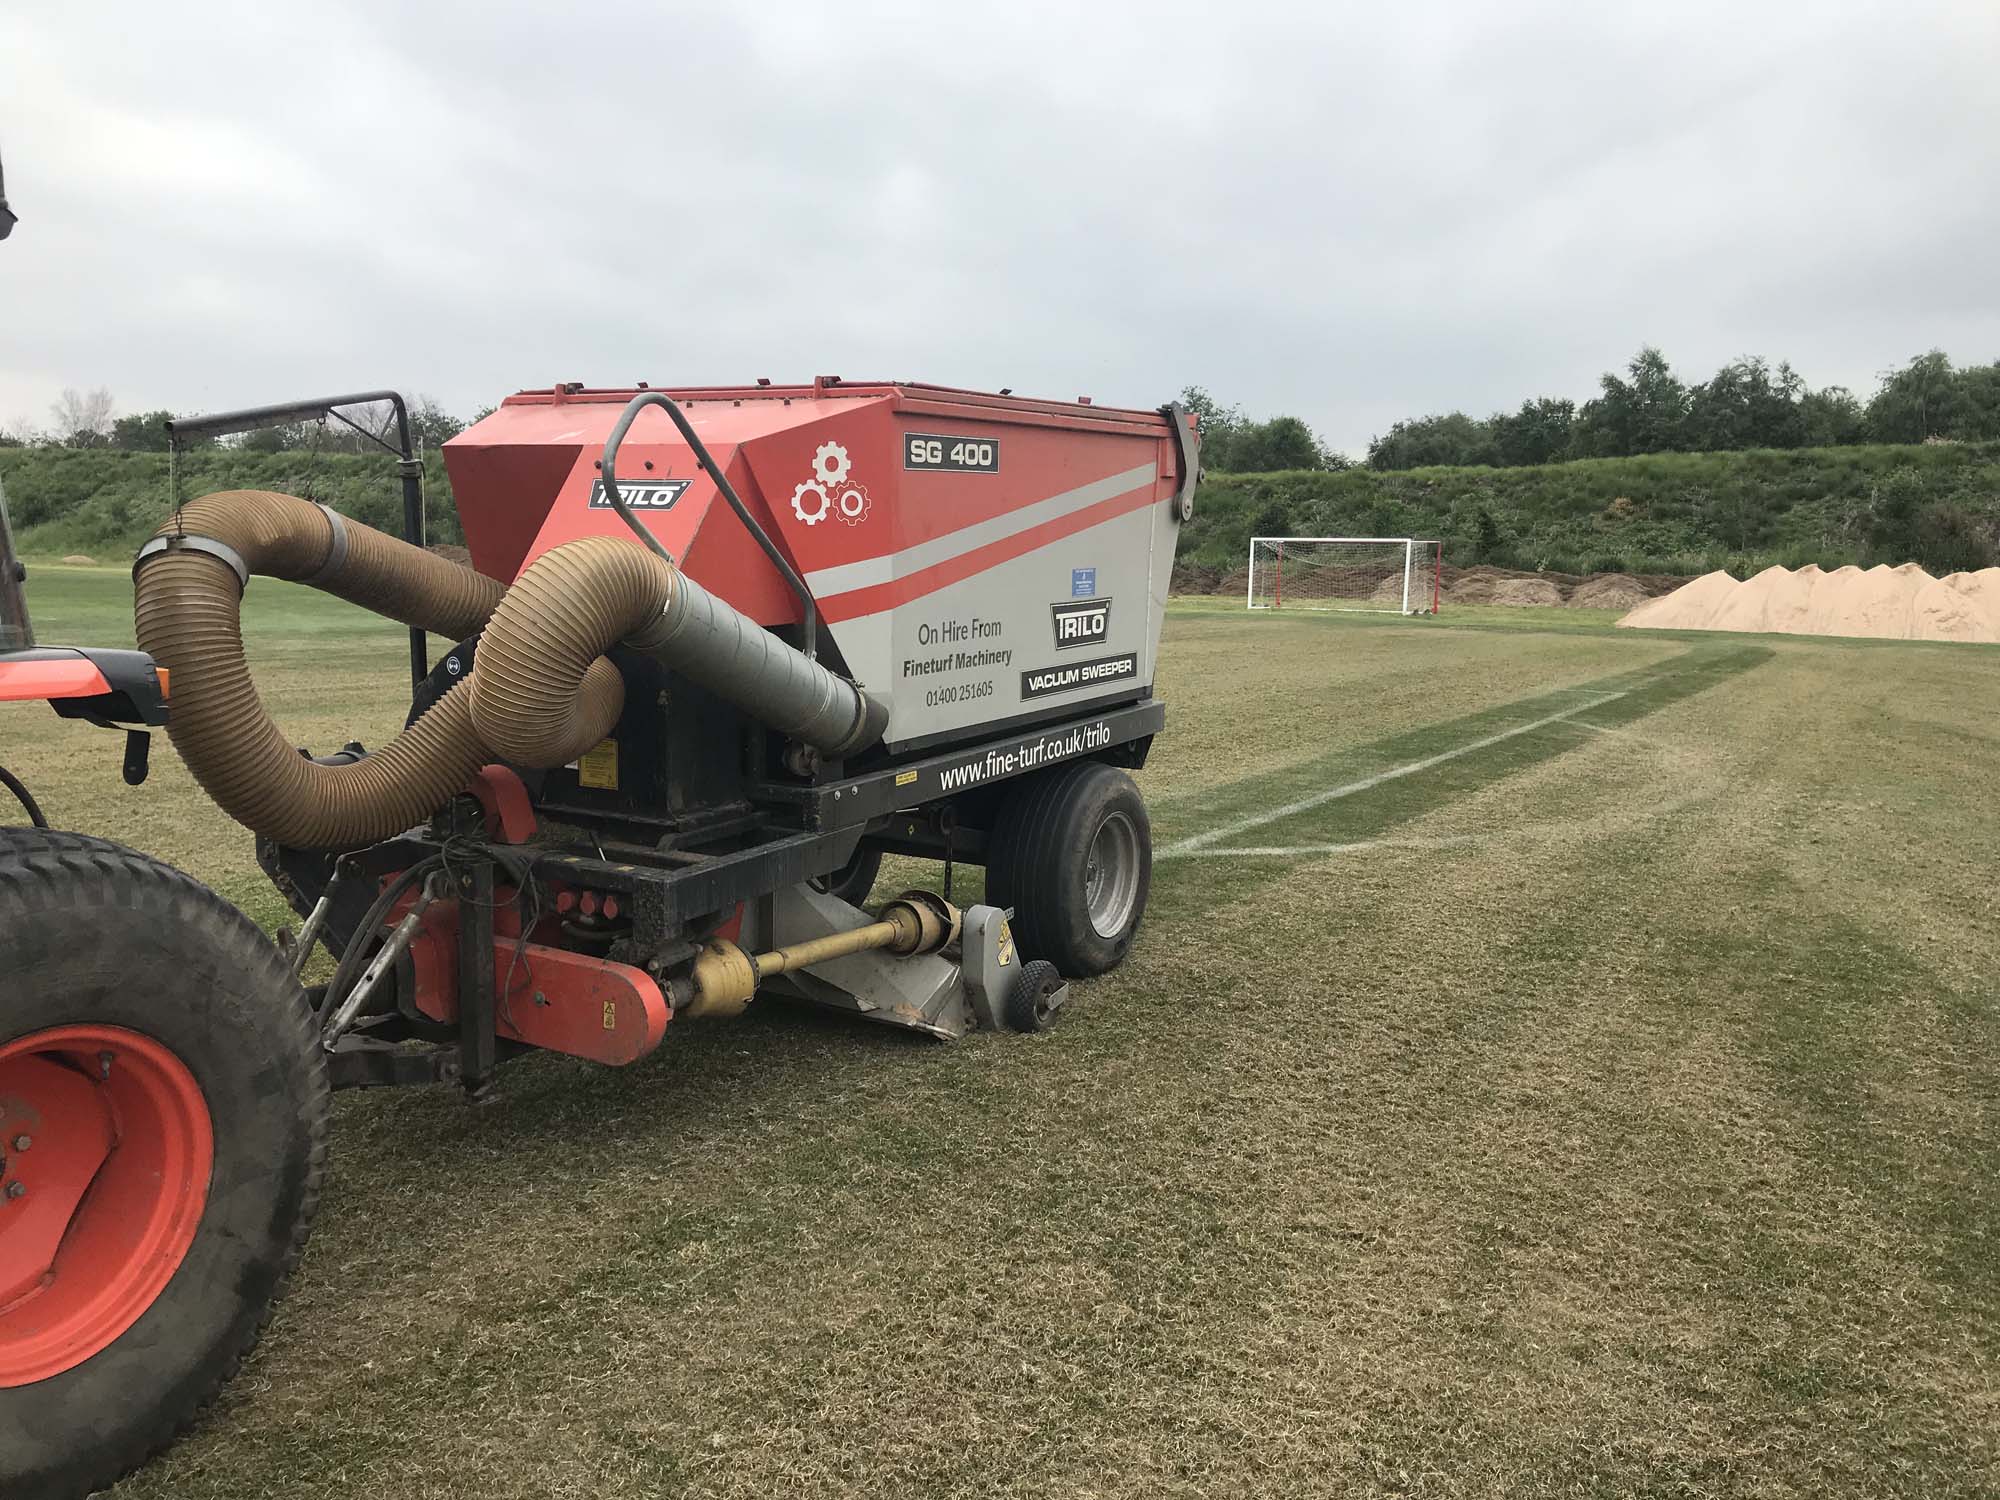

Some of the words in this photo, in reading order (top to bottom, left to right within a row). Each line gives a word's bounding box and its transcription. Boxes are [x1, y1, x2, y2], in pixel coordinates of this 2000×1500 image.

[911, 440, 942, 463] SG
[951, 443, 992, 466] 400
[918, 623, 938, 645] On
[942, 620, 968, 643] Hire
[972, 618, 1002, 639] From
[1056, 608, 1106, 639] TRILO
[903, 654, 953, 678] Fineturf
[955, 649, 1012, 670] Machinery
[1028, 668, 1079, 691] VACUUM
[1081, 659, 1132, 681] SWEEPER
[926, 686, 957, 707] 01400
[959, 680, 993, 702] 251605
[940, 722, 1110, 791] www.fine-turf.co.uk/trilo
